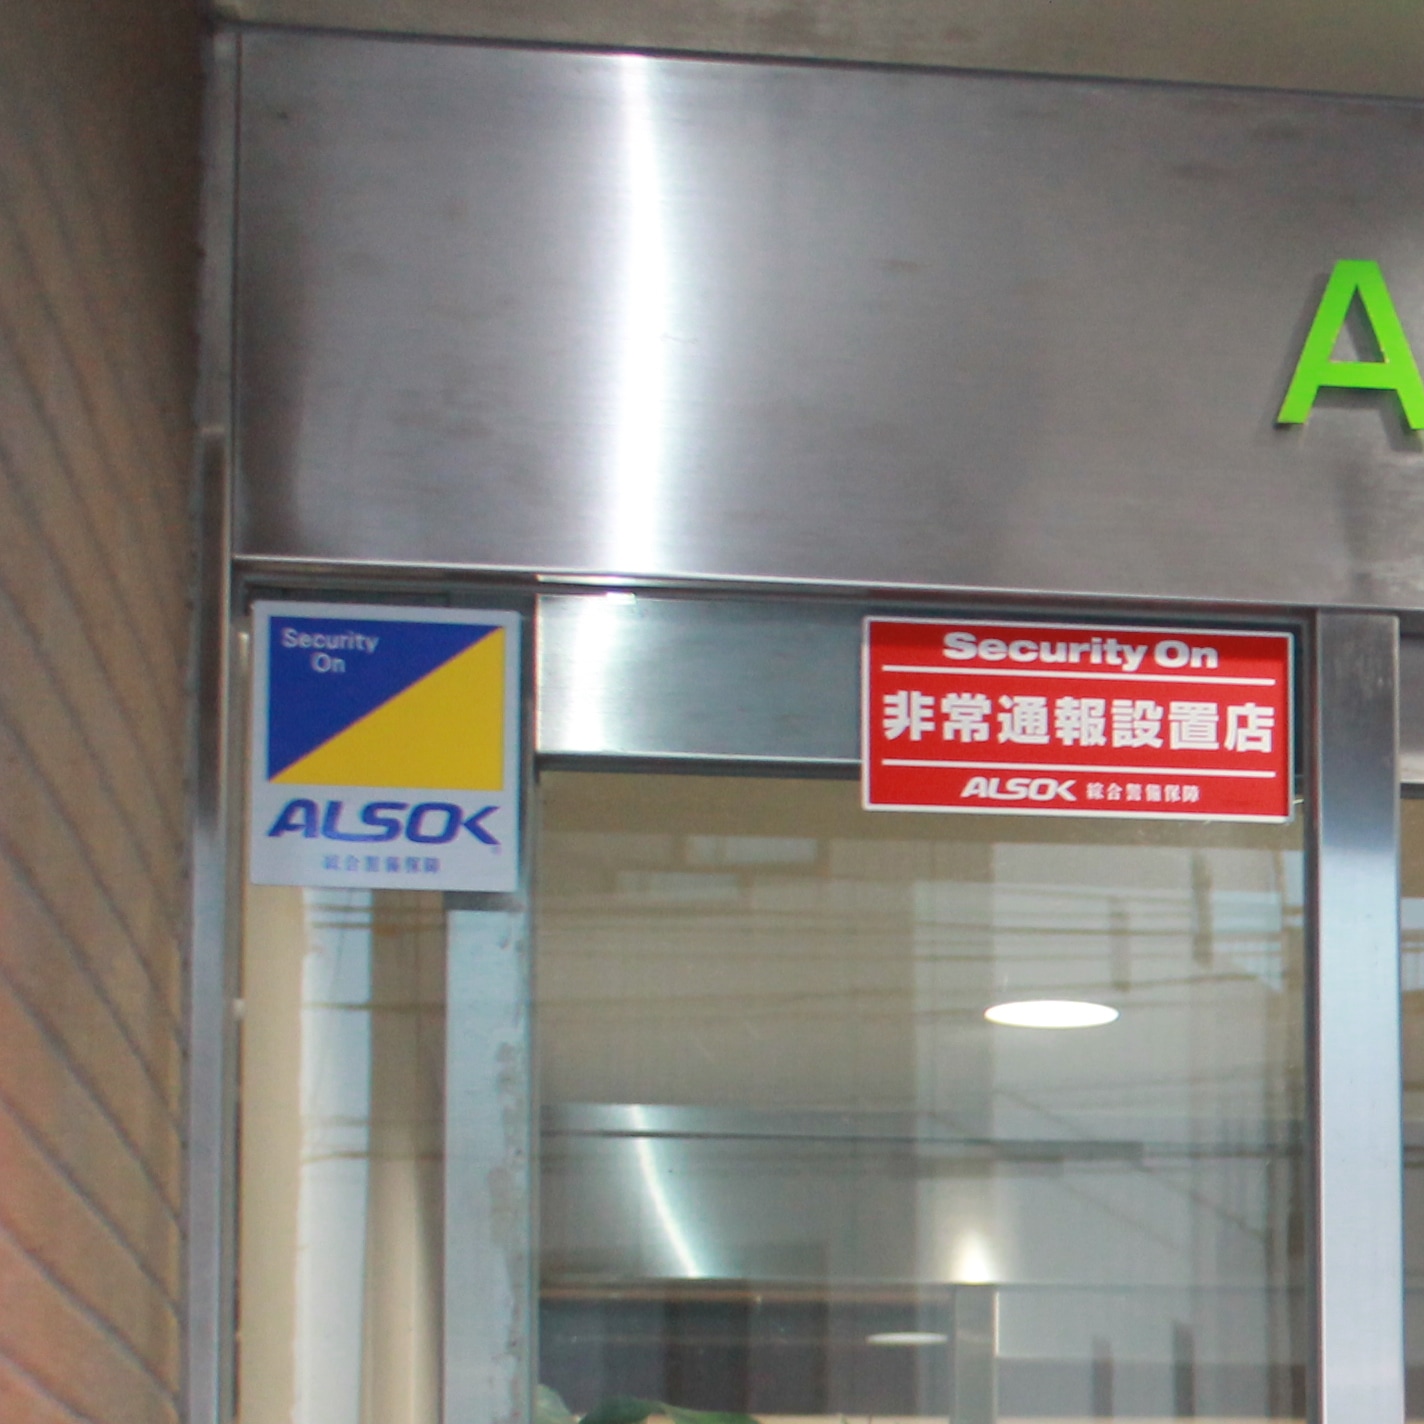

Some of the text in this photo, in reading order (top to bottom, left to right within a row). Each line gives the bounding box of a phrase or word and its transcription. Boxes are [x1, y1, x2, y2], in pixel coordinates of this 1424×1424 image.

[281, 627, 379, 654] Security
[943, 632, 1219, 671] Security On
[311, 653, 346, 674] On
[883, 691, 1275, 753] 非常通報設置店
[961, 776, 1077, 802] ALSOK
[267, 798, 501, 846] ALSOK
